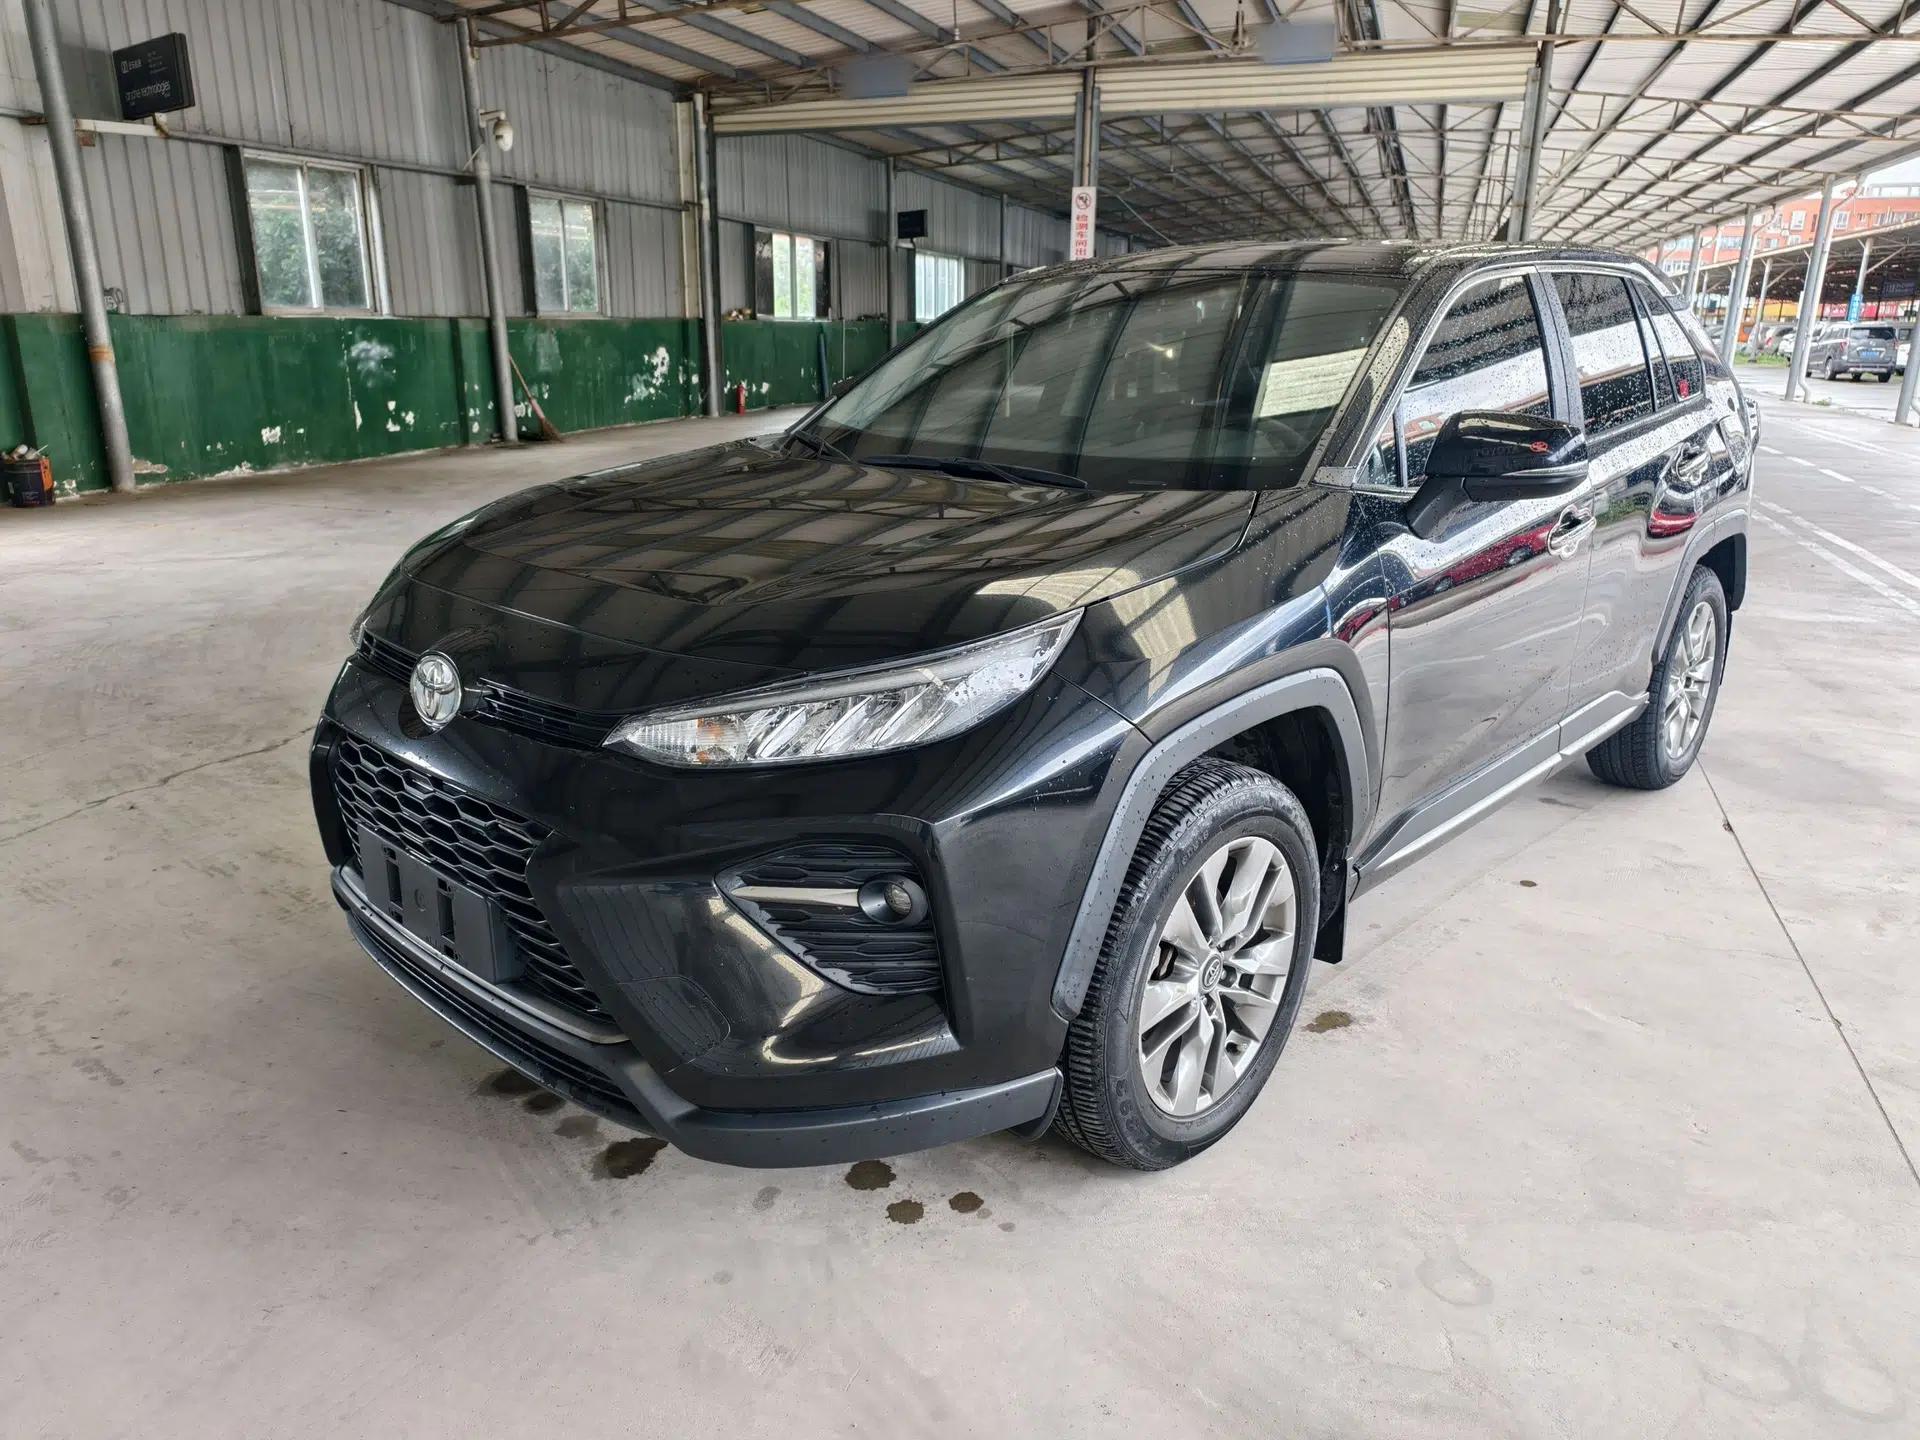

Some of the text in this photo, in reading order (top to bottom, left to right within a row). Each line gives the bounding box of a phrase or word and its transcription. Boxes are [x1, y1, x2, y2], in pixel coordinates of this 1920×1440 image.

[1075, 214, 1088, 259] 检测车间出
